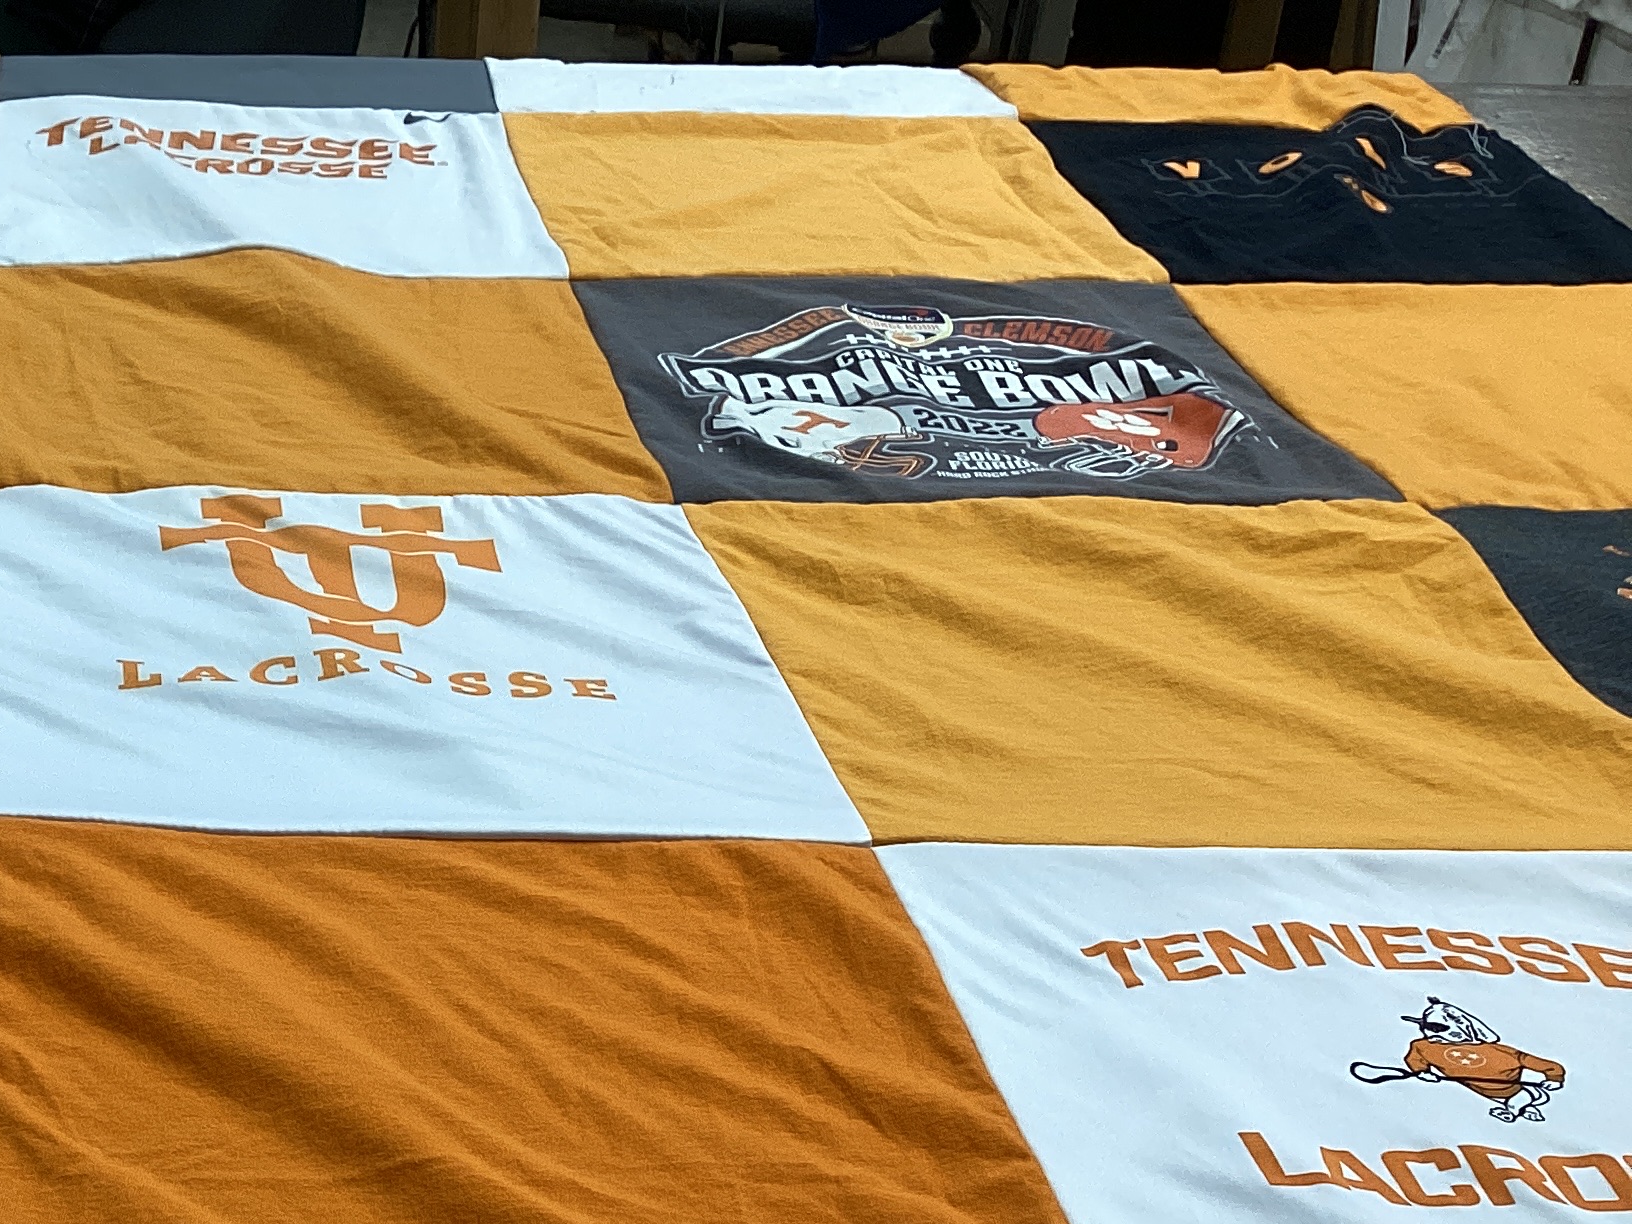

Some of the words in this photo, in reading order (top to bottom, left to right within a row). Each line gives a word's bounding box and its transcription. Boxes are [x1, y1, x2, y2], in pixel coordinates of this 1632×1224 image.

[35, 115, 438, 167] TENNESSEE
[964, 320, 1116, 351] CLEMSON
[964, 358, 1023, 374] ONE
[978, 357, 1205, 408] BOWL
[913, 408, 1028, 437] 2022
[117, 648, 618, 701] LACROSSE
[1238, 1131, 1632, 1213] LACRO
